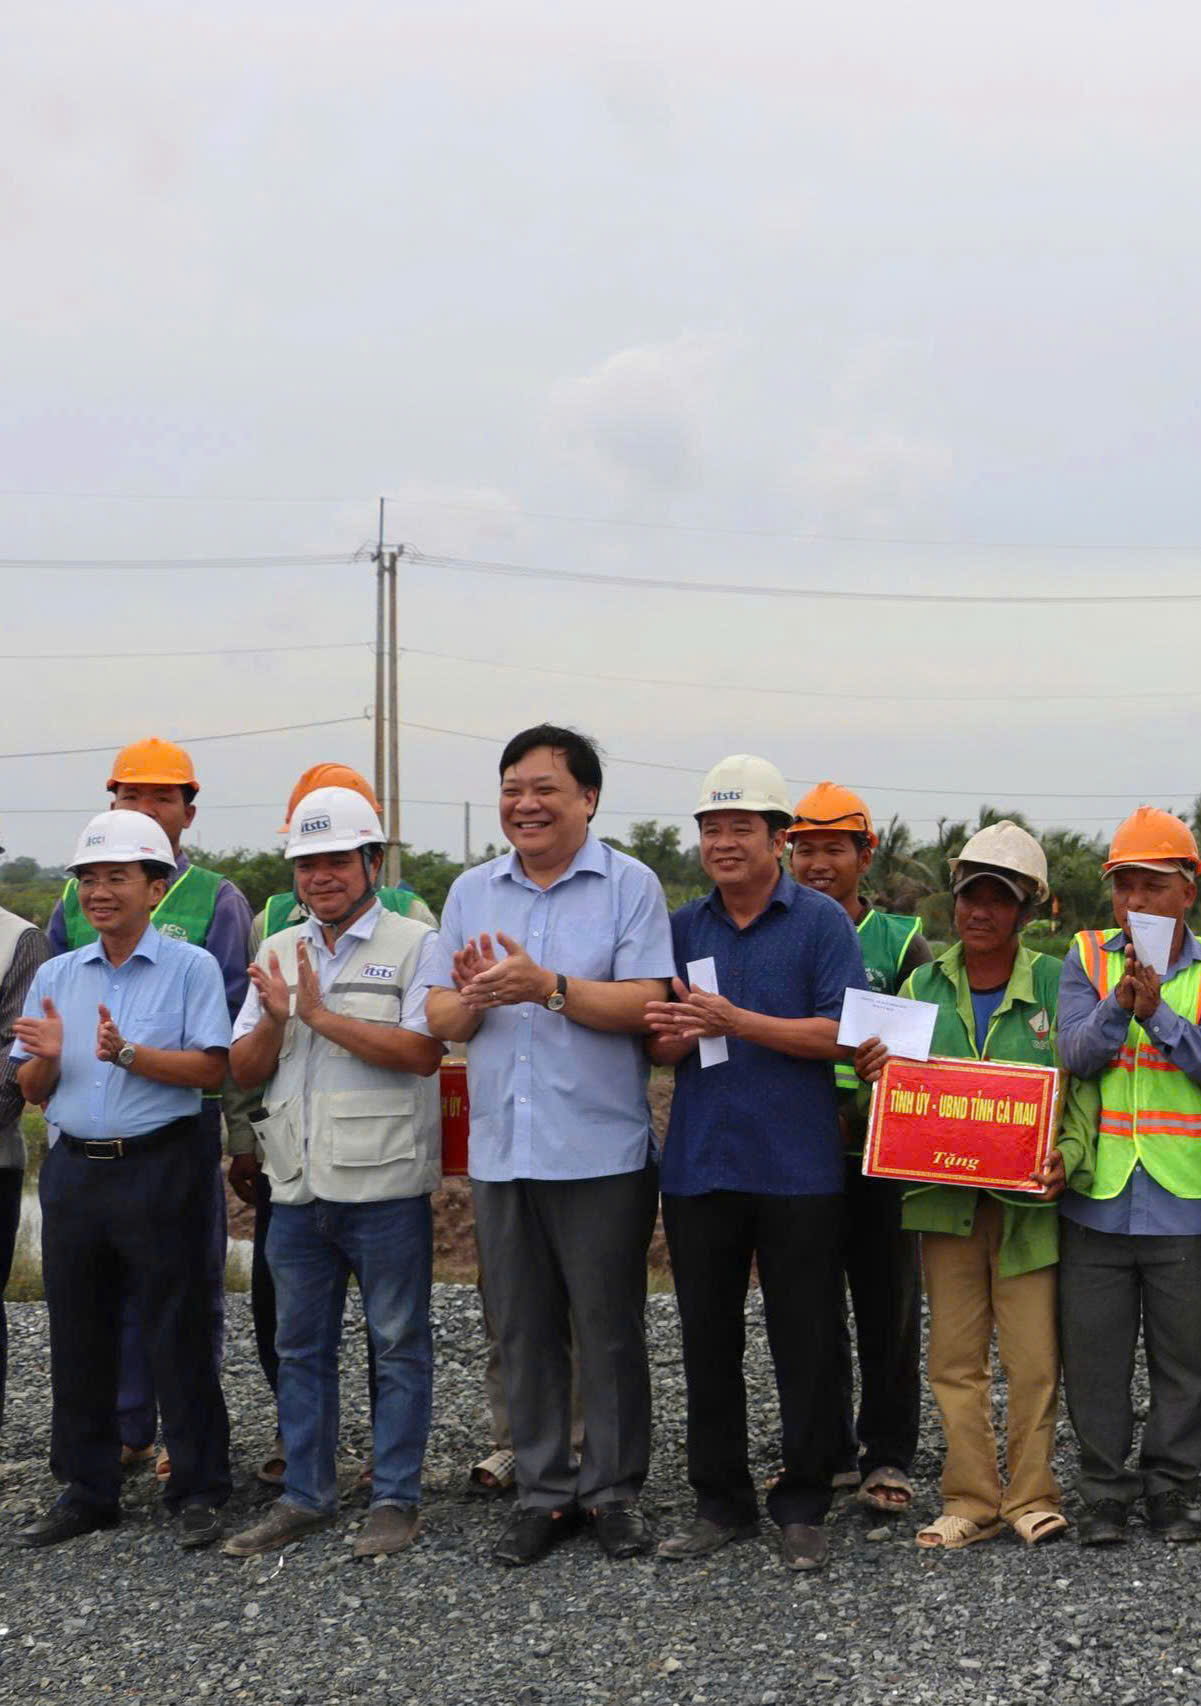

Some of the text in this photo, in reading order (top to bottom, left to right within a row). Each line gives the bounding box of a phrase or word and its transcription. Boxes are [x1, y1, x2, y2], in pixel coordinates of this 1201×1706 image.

[710, 791, 742, 801] itsts
[301, 819, 329, 833] itsts
[364, 963, 393, 978] itsts
[890, 1082, 916, 1114] TỈNH
[915, 1084, 931, 1116] ỦY
[938, 1093, 969, 1120] UBND
[970, 1089, 995, 1122] TỈNH
[996, 1095, 1011, 1124] CÀ
[1012, 1101, 1038, 1126] MAU
[932, 1151, 981, 1171] Tặng
